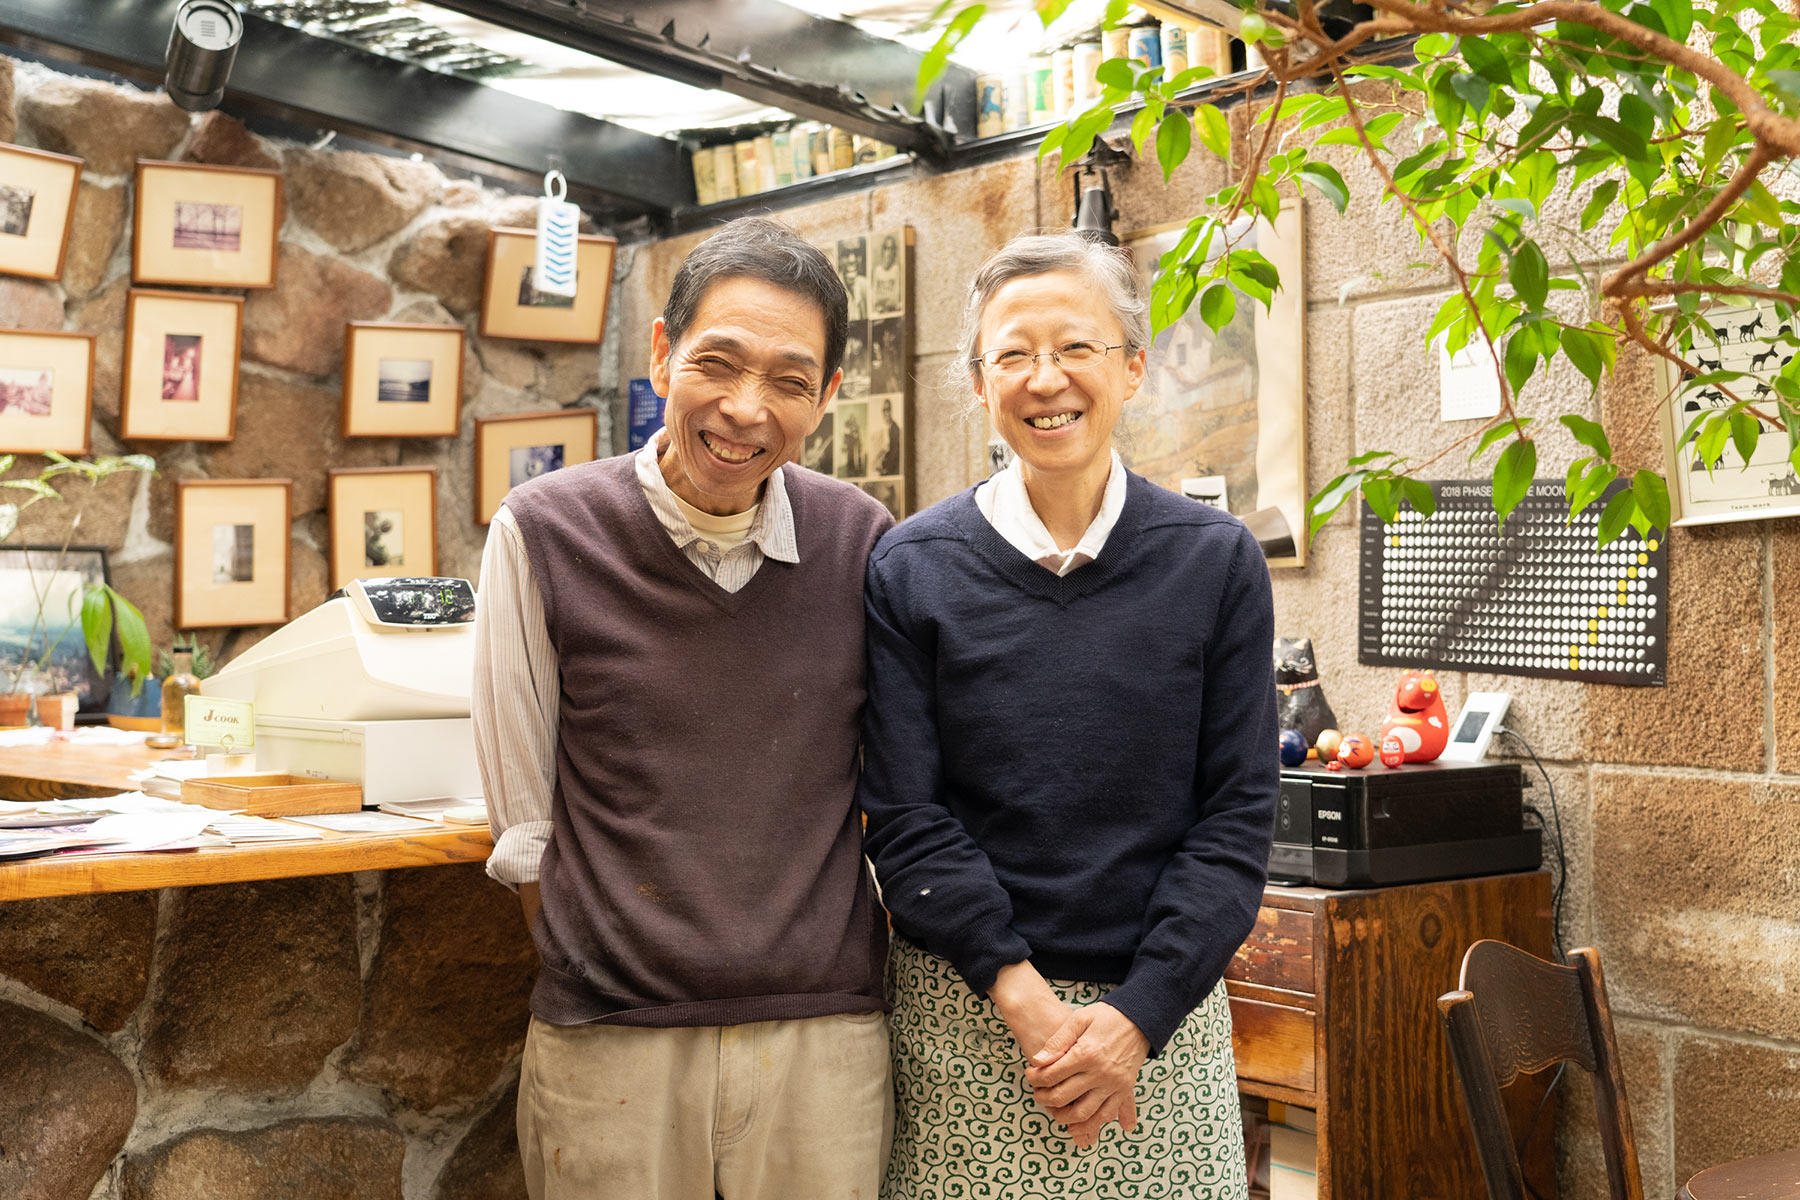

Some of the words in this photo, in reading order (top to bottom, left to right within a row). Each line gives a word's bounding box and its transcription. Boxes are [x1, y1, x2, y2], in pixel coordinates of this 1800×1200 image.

[1440, 486, 1461, 498] 2018
[1536, 485, 1566, 497] MOON
[1317, 809, 1342, 821] EPSON
